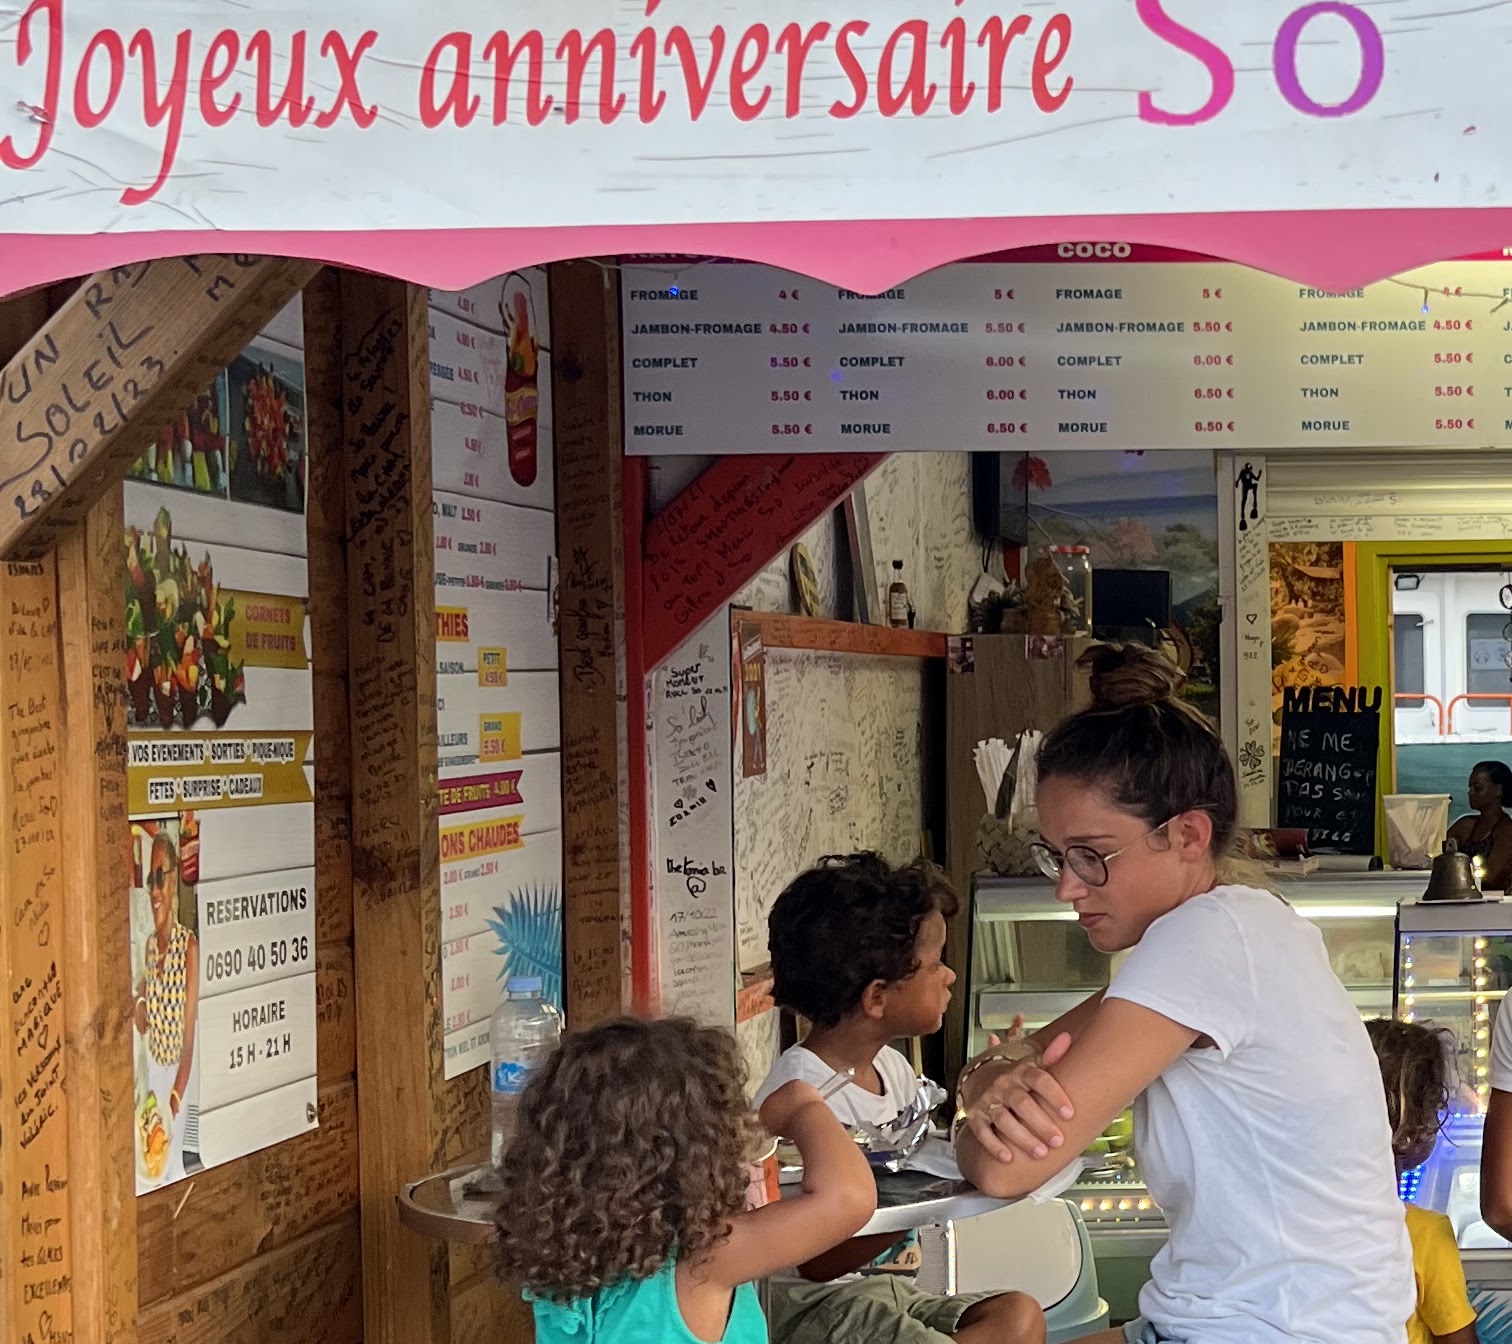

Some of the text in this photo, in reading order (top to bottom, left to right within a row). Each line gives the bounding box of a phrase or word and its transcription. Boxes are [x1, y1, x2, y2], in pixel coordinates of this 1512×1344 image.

[1057, 242, 1131, 258] COCO
[1056, 289, 1121, 299] FROMAGE
[1203, 289, 1210, 298] 5
[631, 324, 761, 334] JAMBON-FROMAGE
[770, 324, 797, 333] 4.50
[8, 334, 59, 403] UN
[632, 358, 698, 368] COMPLET
[770, 357, 798, 367] 5.50
[633, 392, 671, 401] THON
[771, 391, 799, 401] 5.50
[634, 425, 683, 435] MORUE
[772, 424, 800, 434] 5.50
[1059, 423, 1107, 432] MORUE
[1195, 422, 1222, 431] 6.50
[261, 633, 296, 651] FRUITS
[1283, 686, 1382, 713] MENU
[132, 741, 293, 762] VOS EVENEMENTS SORTIES PIQUE-NIQUE
[1321, 732, 1355, 752] ME
[150, 777, 261, 799] FETES SURPRISE CADEAUX
[468, 821, 521, 855] CHAUDES
[207, 888, 306, 926] RESERVATIONS
[207, 936, 308, 981] 0690 40 50 36
[233, 1001, 285, 1033] HORAIRE
[230, 1033, 291, 1069] 15 H 21 H
